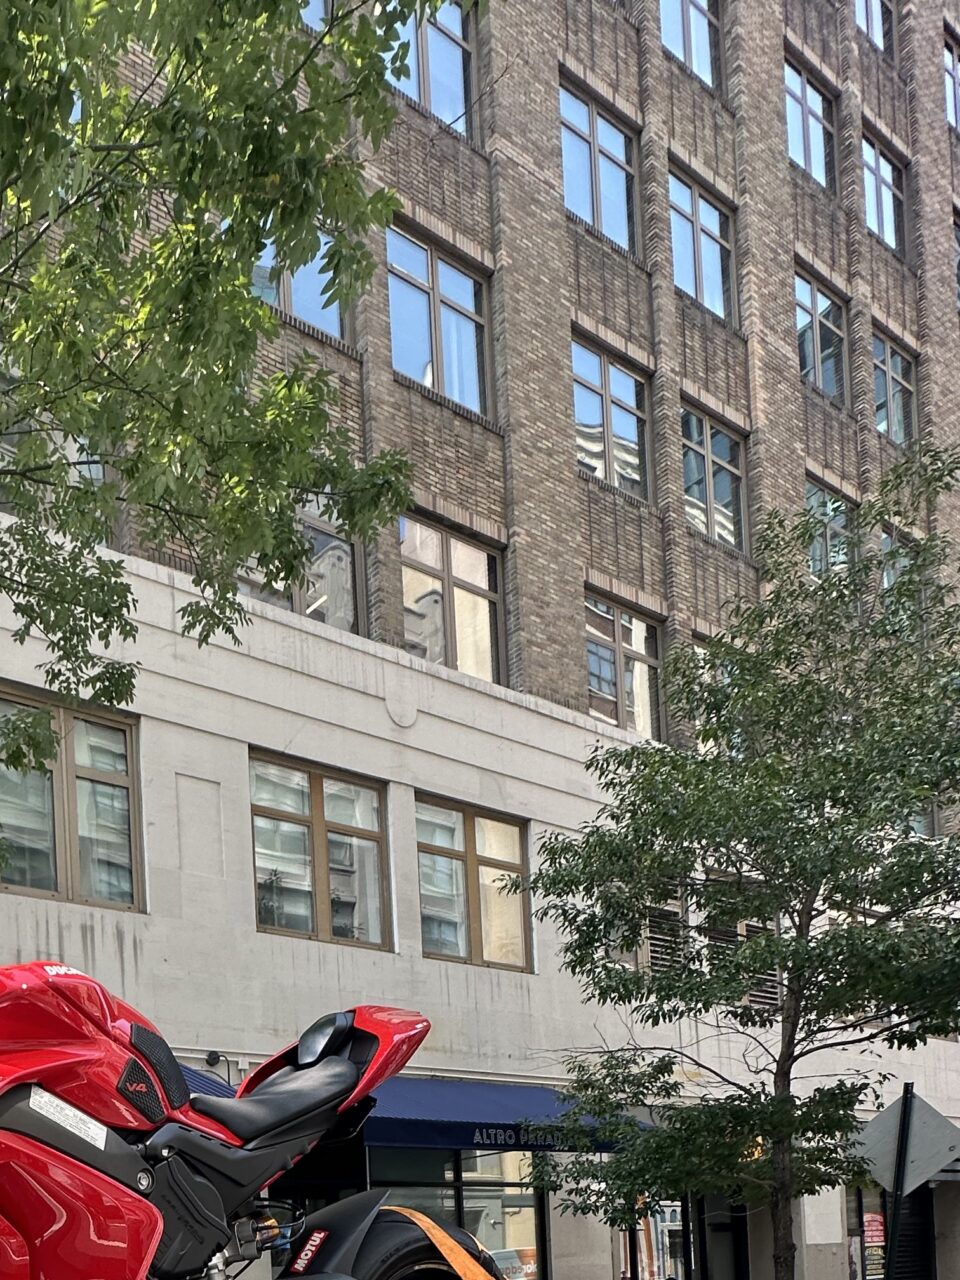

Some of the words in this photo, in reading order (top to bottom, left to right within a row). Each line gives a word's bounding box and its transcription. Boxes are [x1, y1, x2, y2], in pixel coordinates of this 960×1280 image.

[125, 1082, 147, 1092] V4
[473, 1128, 515, 1145] ALTRO
[294, 1231, 325, 1271] MOTUL
